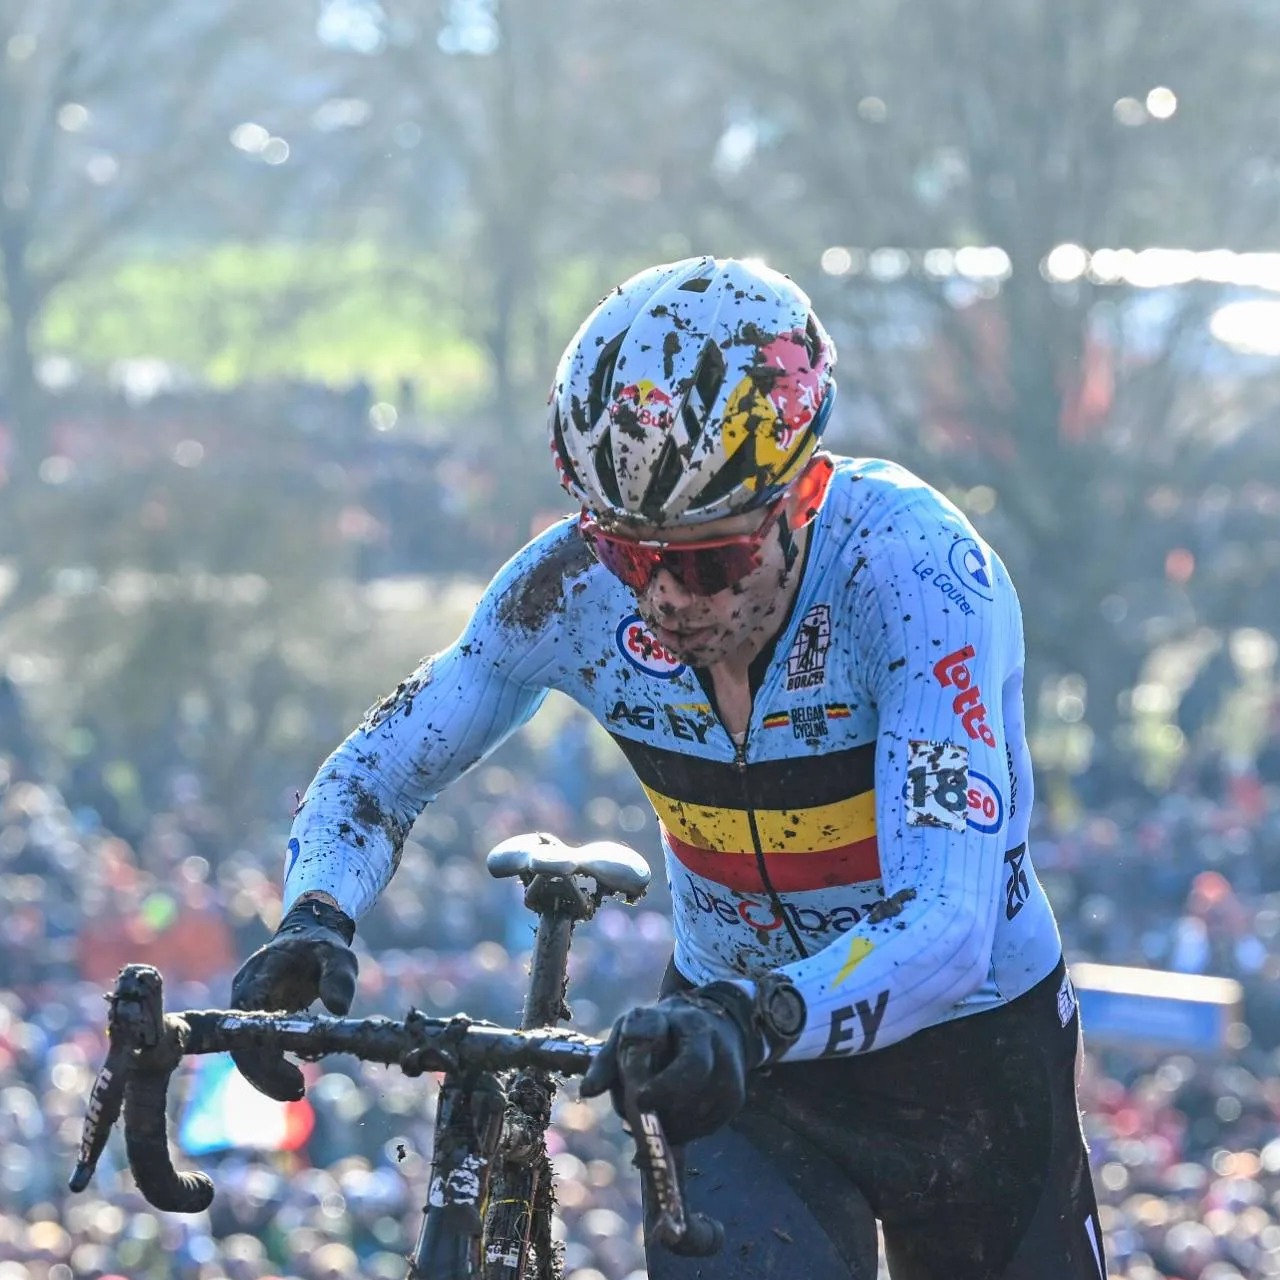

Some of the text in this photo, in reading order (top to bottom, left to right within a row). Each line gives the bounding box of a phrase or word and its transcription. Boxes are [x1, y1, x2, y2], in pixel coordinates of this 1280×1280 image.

[912, 559, 976, 616] Le Couter
[608, 701, 655, 731] AG
[933, 644, 997, 748] Lotto
[671, 715, 709, 745] EY
[907, 765, 968, 812] 18
[821, 989, 890, 1058] EY
